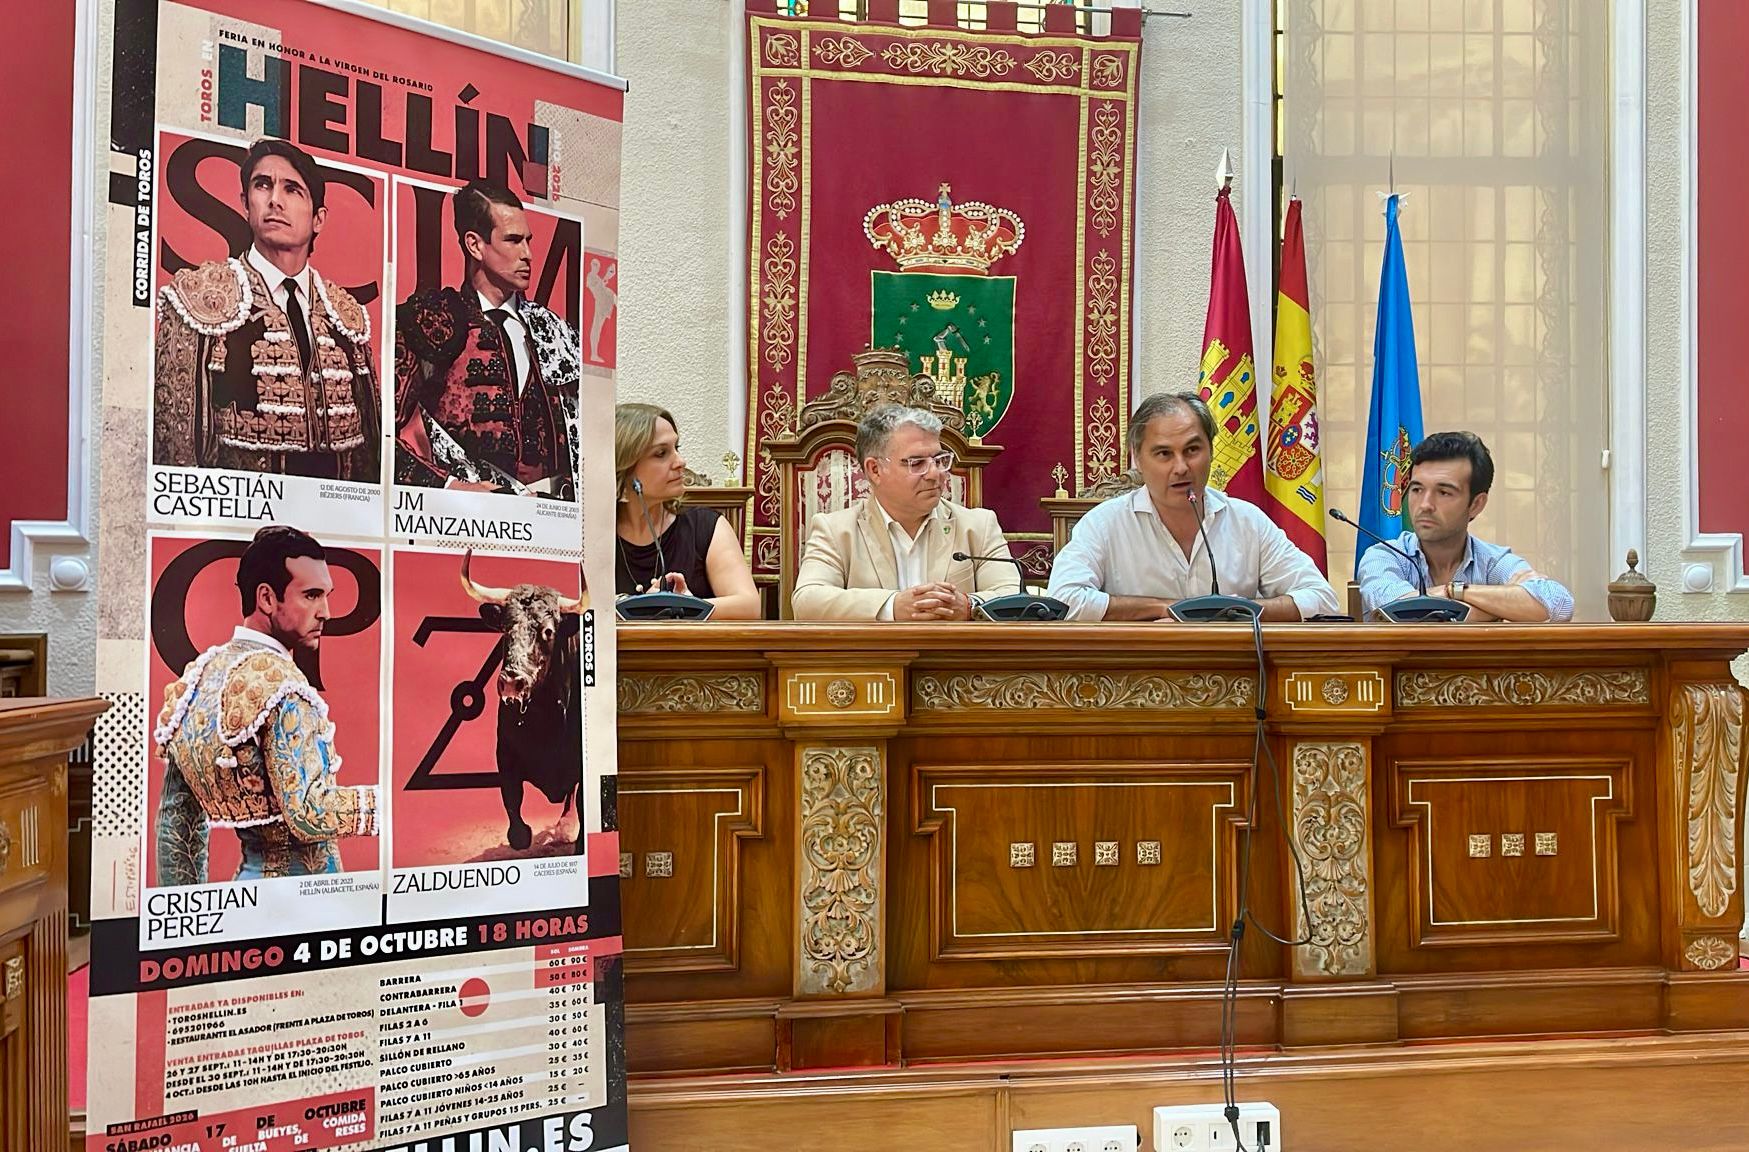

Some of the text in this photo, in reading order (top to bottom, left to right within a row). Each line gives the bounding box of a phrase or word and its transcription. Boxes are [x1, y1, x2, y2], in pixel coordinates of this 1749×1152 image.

[219, 30, 433, 92] FERIA EN HONOR A LA VIRGEN DEL ROSARIO
[200, 70, 212, 122] TOROS
[218, 43, 549, 200] HELLÍN
[136, 149, 152, 300] CORRIDA DE TOROS
[154, 472, 283, 500] SEBASTIÁN
[154, 495, 275, 521] CASTELLA
[393, 492, 424, 511] JM
[395, 514, 532, 542] MANZANARES
[584, 612, 594, 684] 6 TOROS 6
[393, 866, 521, 894] ZALDUENDO
[147, 886, 258, 916] CRISTIAN
[148, 912, 224, 940] PÉREZ
[140, 914, 589, 984] DOMINGO 4 DE OCTUBRE 18 HORAS
[380, 974, 422, 987] BARRERA
[380, 986, 457, 1002] CONTRABARRERA
[169, 990, 304, 1014] ENTRADAS YA DISPONIBLES EN:
[173, 1008, 247, 1024] TOROSHELLIN.ES
[380, 1004, 430, 1016] DELANTERA
[438, 1000, 456, 1010] FILA
[170, 1032, 227, 1046] RESTAURANTE
[238, 1024, 272, 1035] ASADOR
[273, 1020, 304, 1032] (FRENTE
[304, 1018, 310, 1026] A
[311, 1015, 336, 1025] PLAZA
[336, 1014, 346, 1022] DE
[346, 1010, 374, 1020] TOROS)
[172, 1021, 225, 1034] 695201966
[380, 1022, 404, 1032] FILAS
[406, 1020, 412, 1029] 2
[423, 1018, 428, 1026] 6
[167, 1058, 195, 1068] VENTA
[197, 1049, 246, 1062] ENTRADAS
[247, 1041, 294, 1055] TAQUILLAS
[296, 1037, 323, 1048] PLAZA
[337, 1030, 365, 1040] TOROS
[380, 1032, 431, 1047] FILAS 7 A 11
[380, 1042, 466, 1063] SILLÓN DE RELLANO
[166, 1070, 178, 1079] 26
[189, 1066, 200, 1075] 27
[202, 1062, 230, 1072] SEPT.:
[233, 1055, 265, 1068] 11-14H
[274, 1052, 285, 1060] DE
[288, 1043, 347, 1058] 17:30-20:30H
[166, 1078, 194, 1089] DESDE
[196, 1076, 206, 1084] EL
[208, 1074, 220, 1082] 30
[222, 1068, 250, 1080] SEPT.:
[252, 1063, 284, 1076] 11-14H
[294, 1060, 304, 1068] DE
[306, 1050, 365, 1066] 17:30-20:30H
[380, 1059, 452, 1078] PALCO CUBIERTO
[166, 1091, 172, 1099] 4
[173, 1088, 195, 1098] OCT.:
[196, 1082, 224, 1094] DESDE
[225, 1081, 241, 1090] LAS
[244, 1078, 260, 1086] 10H
[260, 1073, 288, 1084] HASTA
[298, 1068, 324, 1078] INICIO
[325, 1066, 340, 1074] DEL
[340, 1060, 374, 1070] FESTEJO.
[380, 1066, 496, 1093] PALCO CUBIERTO >65 AÑOS
[380, 1076, 523, 1108] PALCO CUBIERTO NIÑOS <14 AÑOS
[380, 1090, 524, 1124] FILAS 7 A 11 JÓVENES 14-25 AÑOS
[380, 1102, 542, 1138] FILAS 7 A 11 PEÑAS Y GRUPOS 15 PERS.
[106, 1133, 172, 1152] SÁBADO
[206, 1124, 227, 1138] 17
[256, 1115, 275, 1130] DE
[304, 1098, 366, 1120] OCTUBRE
[110, 1112, 194, 1134] SAN RAFAEL 2026
[222, 1112, 366, 1148] DE BUEYES, COMIDA
[294, 1123, 366, 1145] DE RESES
